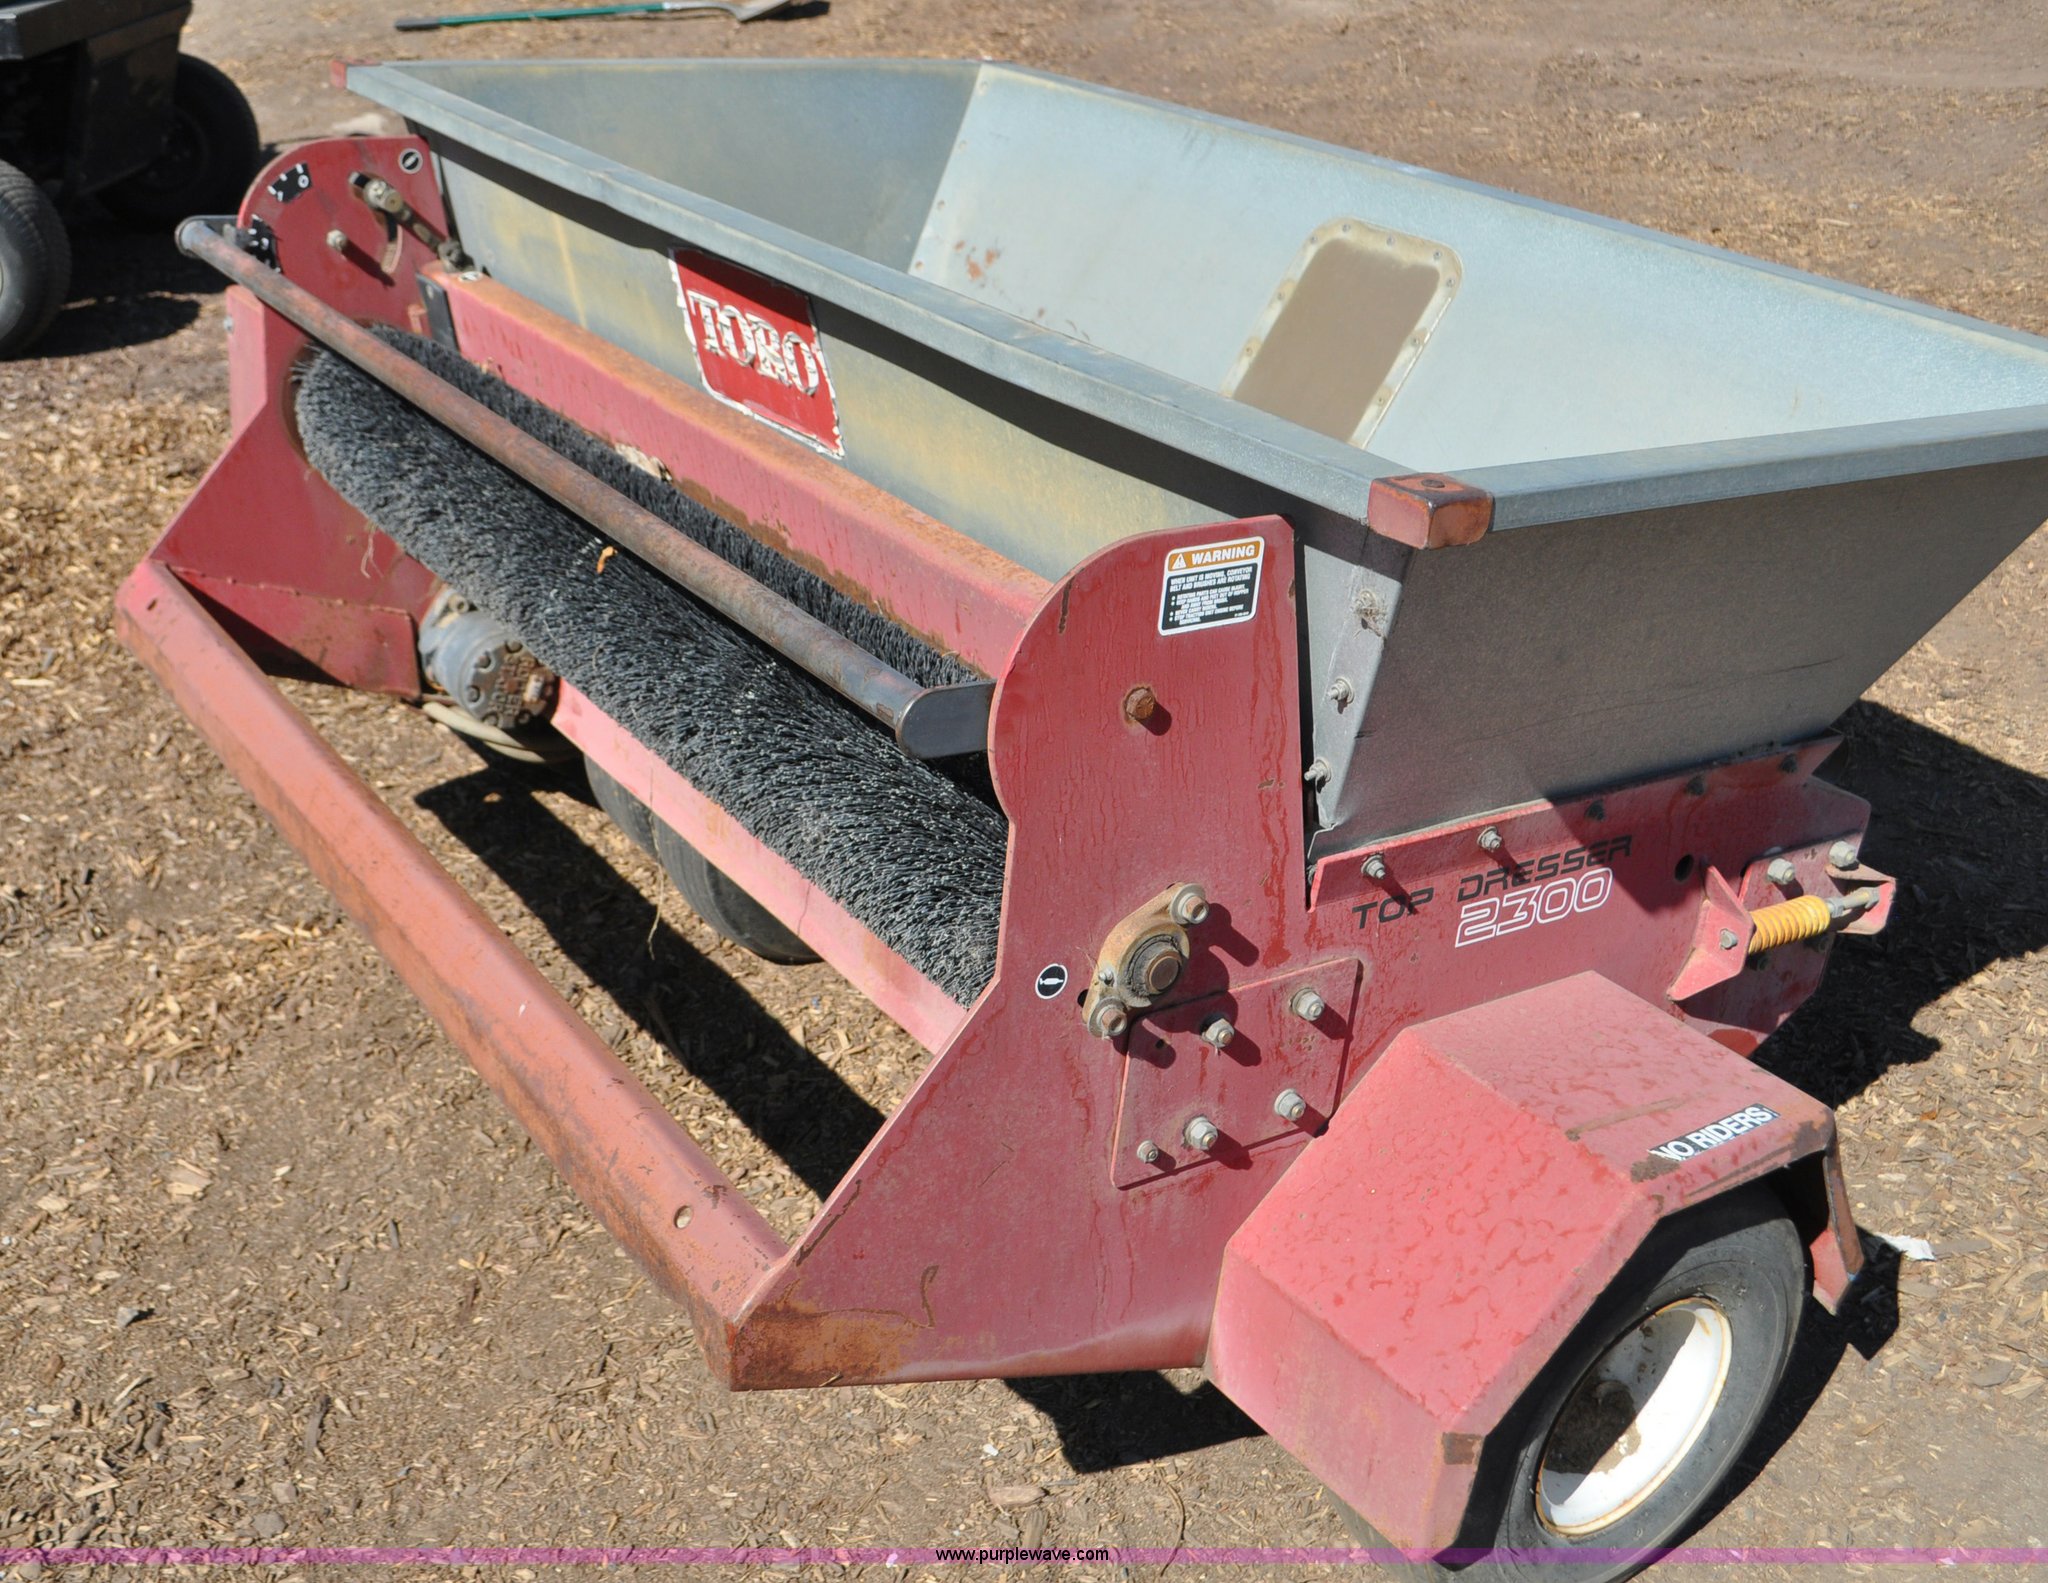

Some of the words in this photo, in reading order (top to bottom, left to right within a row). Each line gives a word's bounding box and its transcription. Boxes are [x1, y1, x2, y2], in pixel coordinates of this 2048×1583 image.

[686, 289, 819, 396] TORO
[1191, 545, 1255, 565] WARNING
[1352, 887, 1434, 930] TOP
[1457, 835, 1632, 903] DRESSER
[1455, 867, 1613, 948] 2300
[1686, 1106, 1773, 1149] RIDERS
